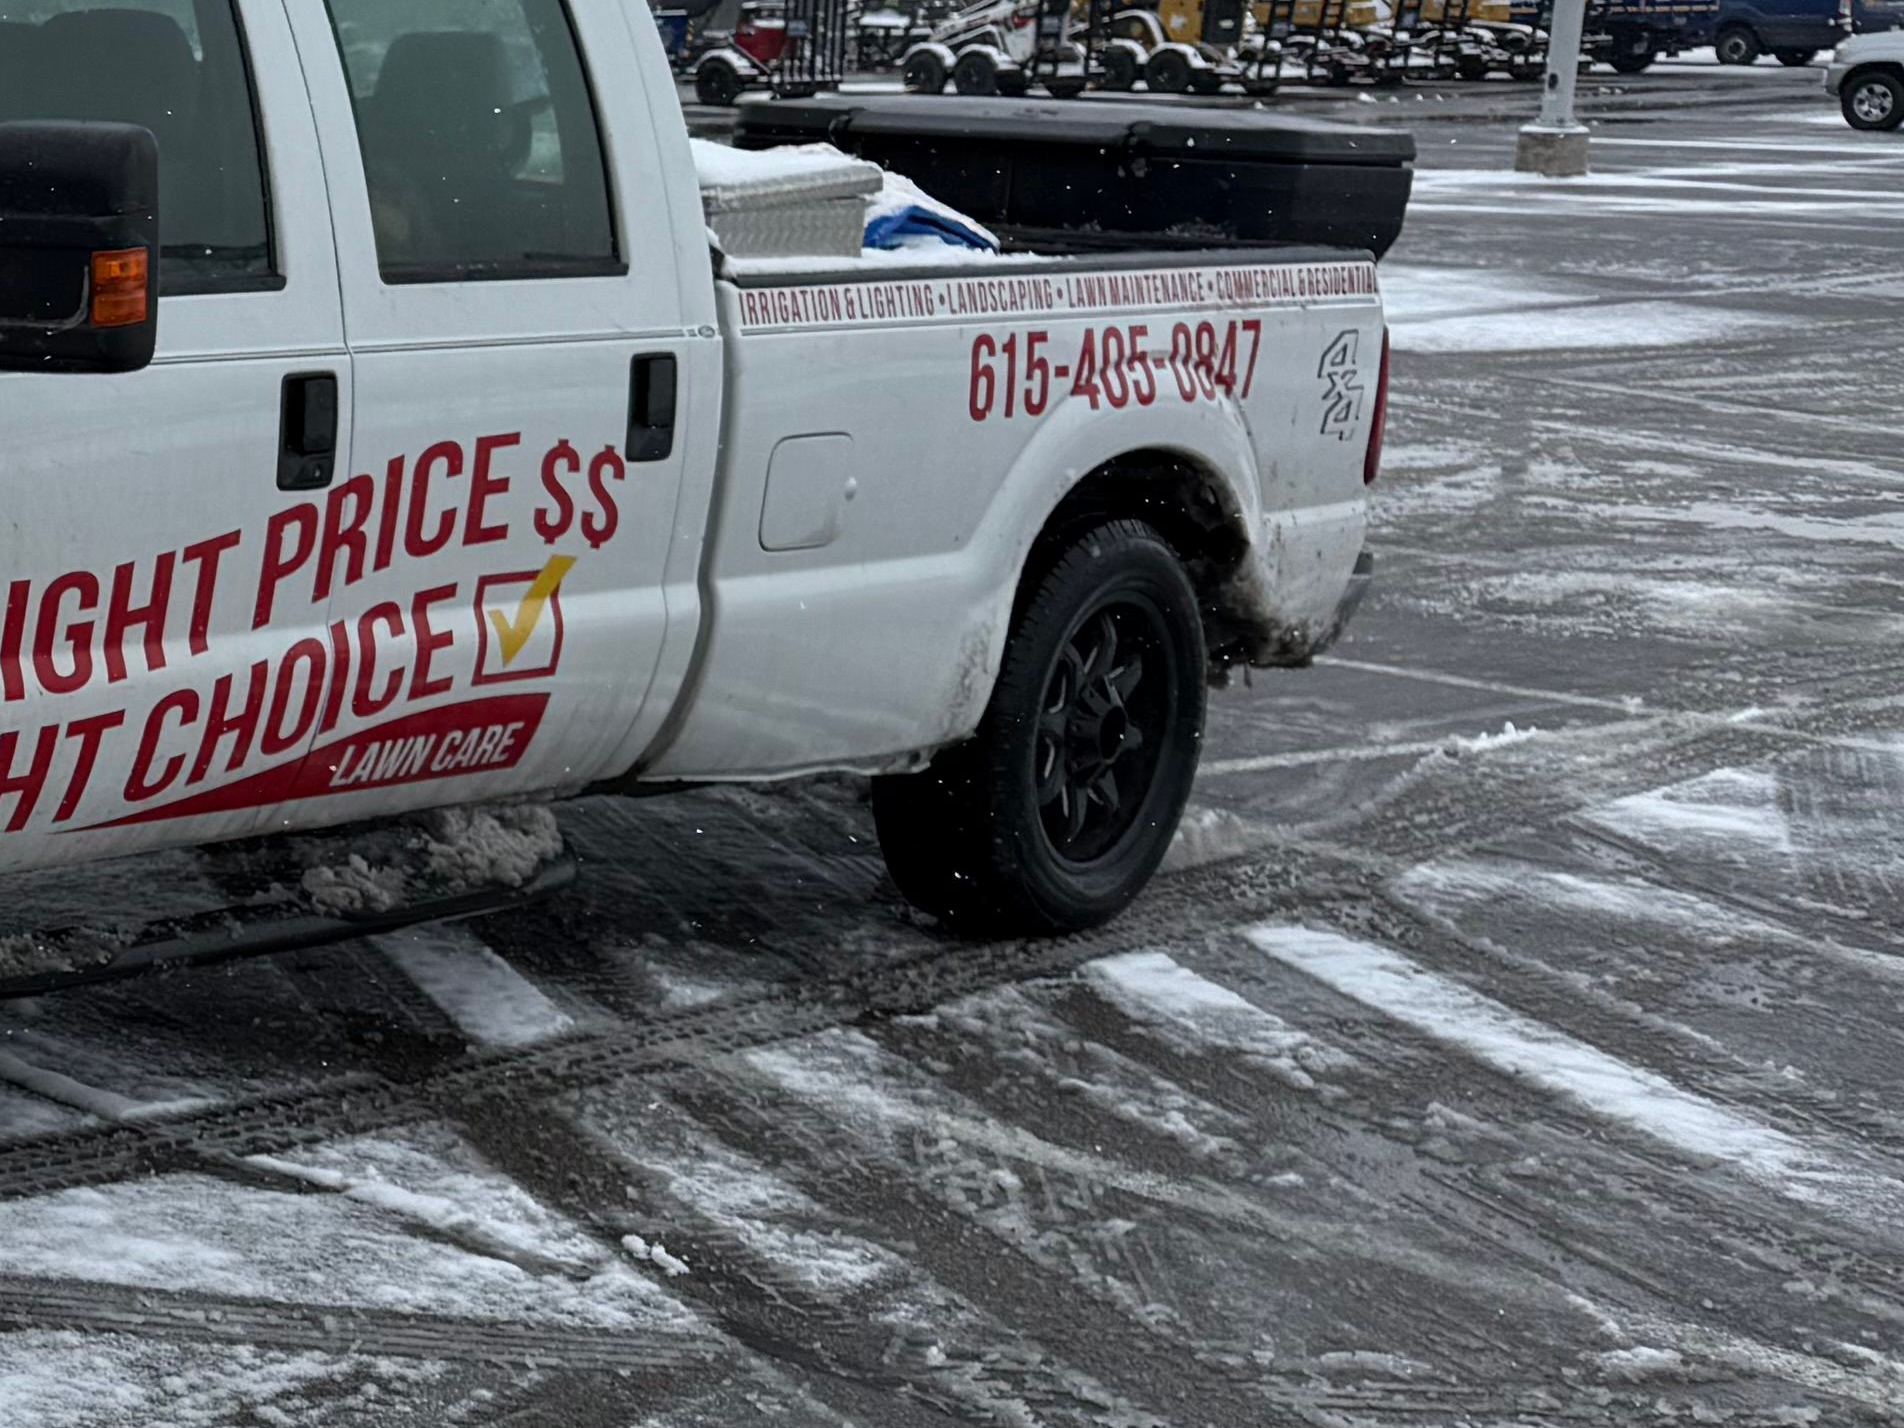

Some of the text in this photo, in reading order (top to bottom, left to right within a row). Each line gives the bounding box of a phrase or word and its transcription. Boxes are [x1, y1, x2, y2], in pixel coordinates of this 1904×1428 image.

[739, 288, 840, 326] IRRIGATION
[857, 283, 935, 320] LIGHTING
[946, 278, 1054, 314] LANDSCAPING
[1066, 271, 1206, 308] LAWN MAINTENANCE
[1215, 267, 1298, 300] COMMERCIAL
[251, 431, 521, 631] PRICE
[533, 438, 626, 550] $$
[123, 582, 459, 802] CHOICE
[328, 721, 524, 788] LAWN CARE
